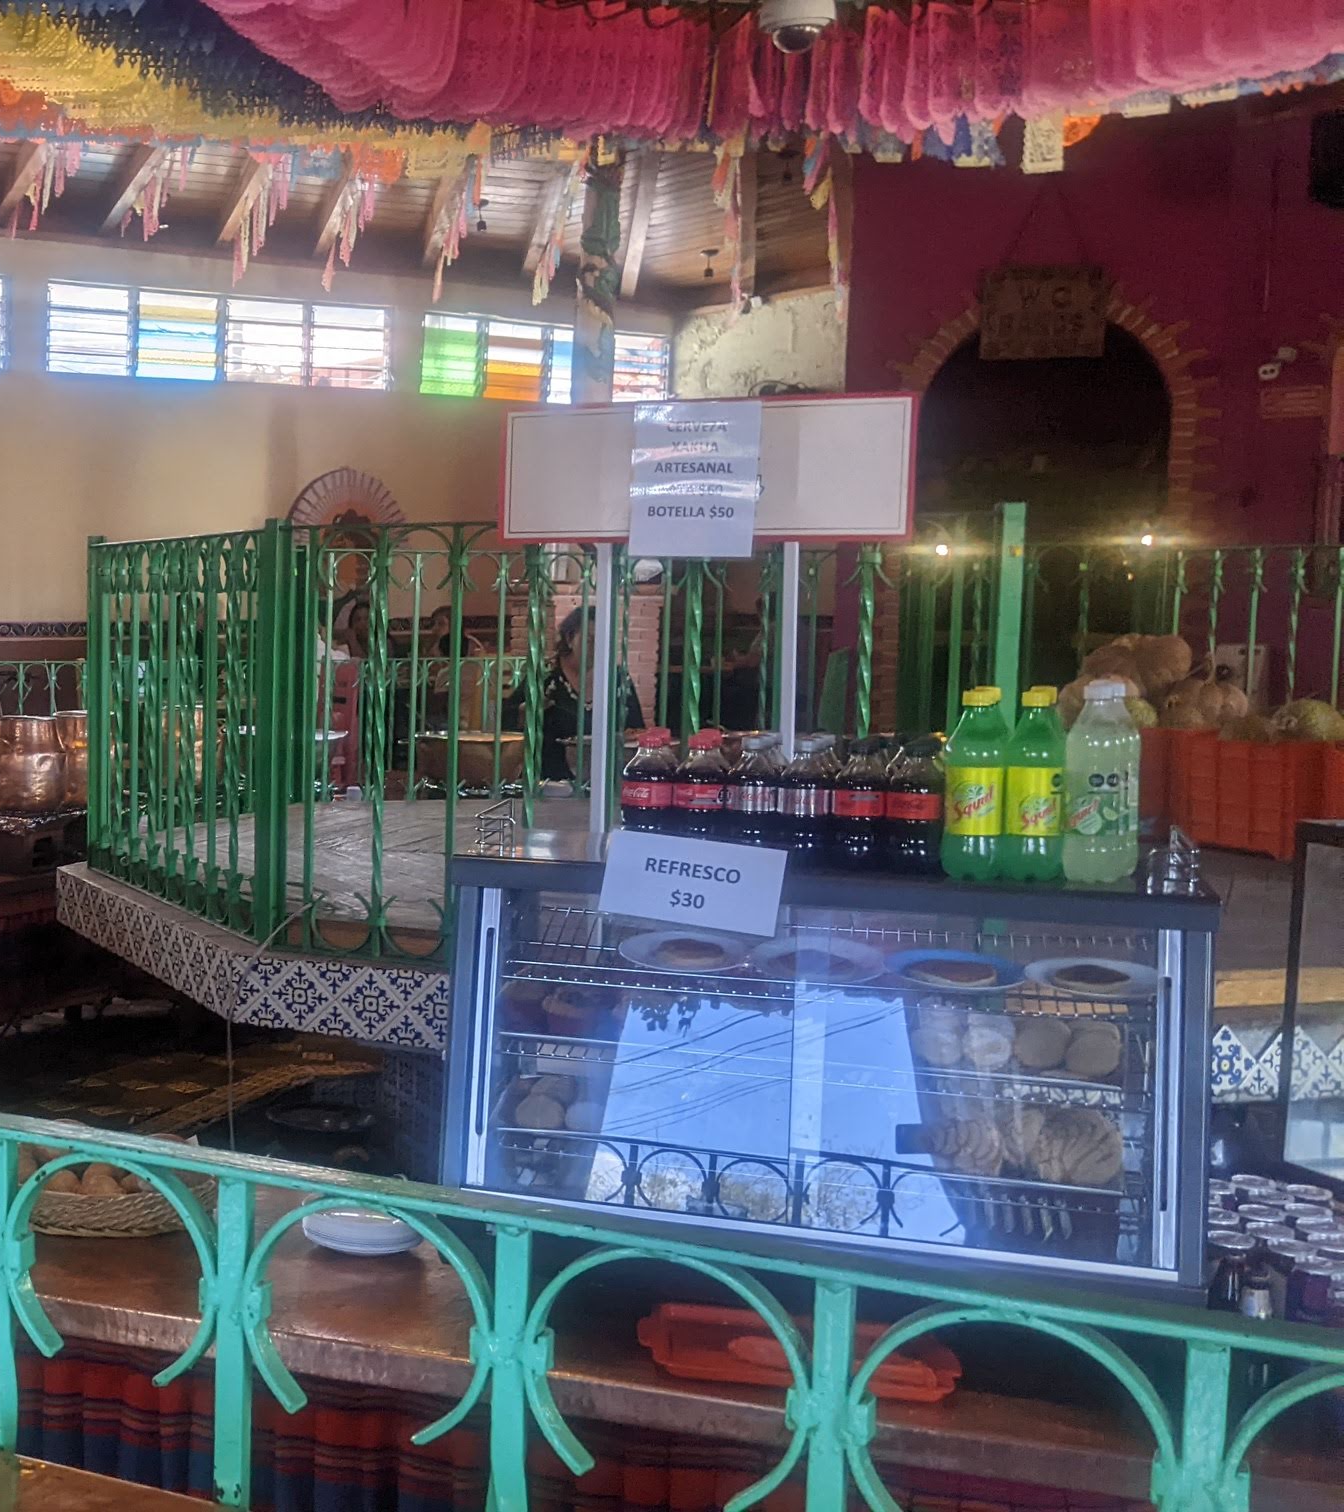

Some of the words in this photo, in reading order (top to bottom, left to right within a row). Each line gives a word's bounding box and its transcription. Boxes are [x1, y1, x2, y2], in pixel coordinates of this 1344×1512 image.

[667, 420, 728, 433] CERVEZA
[654, 462, 734, 474] ARTESANAL
[647, 506, 705, 518] BOTELLA
[709, 504, 735, 519] $50
[644, 857, 742, 884] REFRESCO
[669, 889, 705, 909] $30
